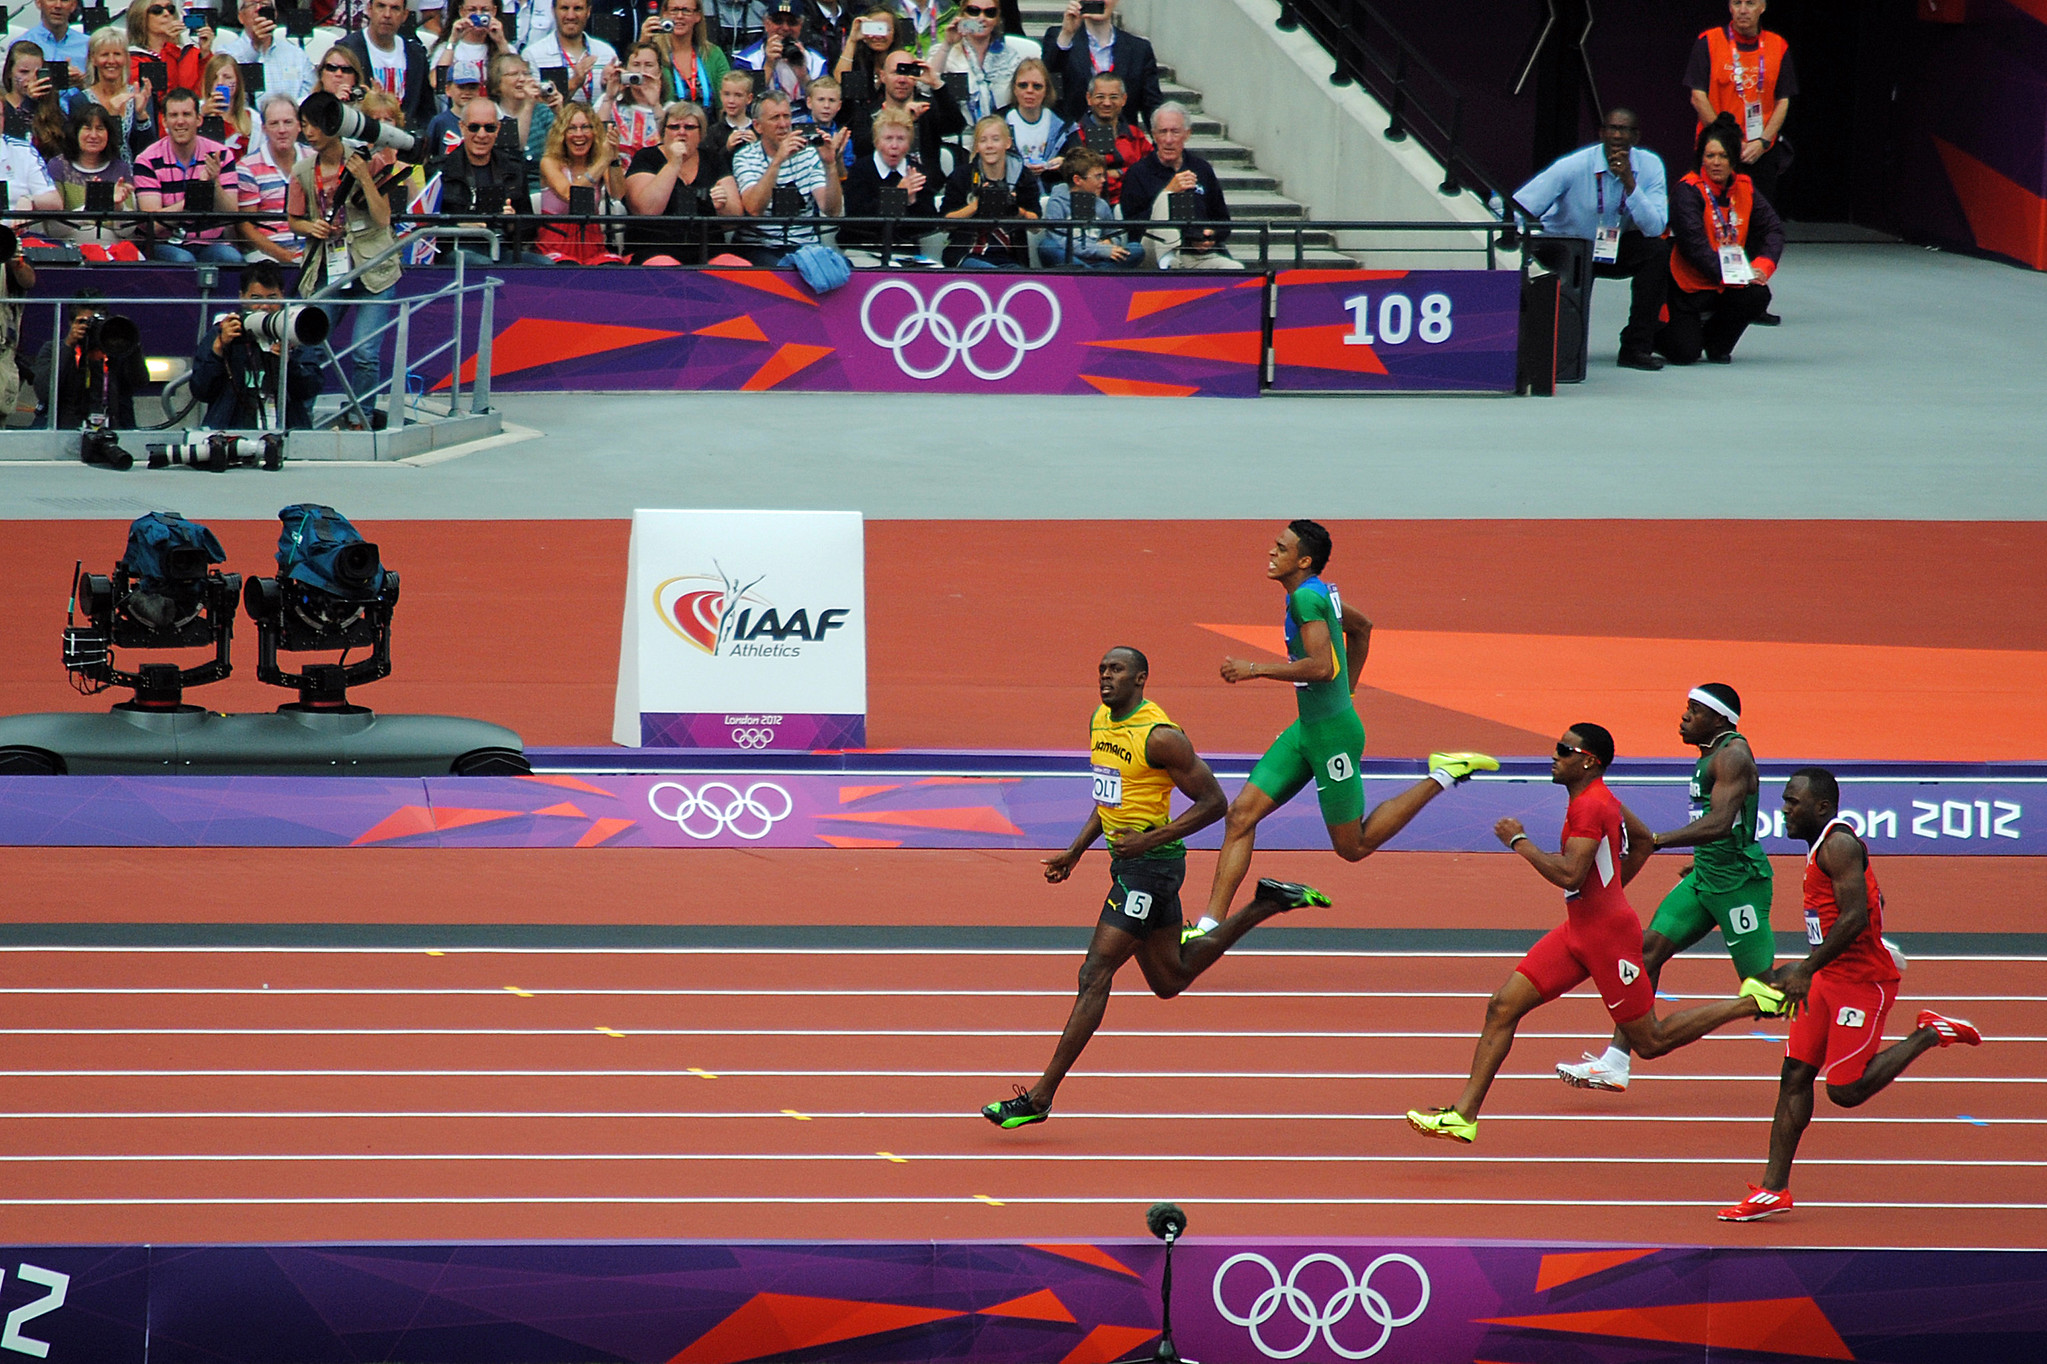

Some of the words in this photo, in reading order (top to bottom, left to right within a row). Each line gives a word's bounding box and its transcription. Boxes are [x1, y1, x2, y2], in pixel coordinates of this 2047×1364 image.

[1343, 294, 1452, 345] 108
[733, 607, 851, 642] IAAF
[729, 644, 801, 657] Athletics
[724, 714, 760, 725] London
[760, 714, 783, 725] 2012
[1091, 740, 1132, 764] JAMAICA
[1333, 757, 1345, 778] 9
[1912, 800, 2021, 839] 2012
[1132, 895, 1146, 914] 5
[1739, 909, 1751, 930] 6
[1623, 963, 1635, 979] 4
[0, 1262, 71, 1359] 2
